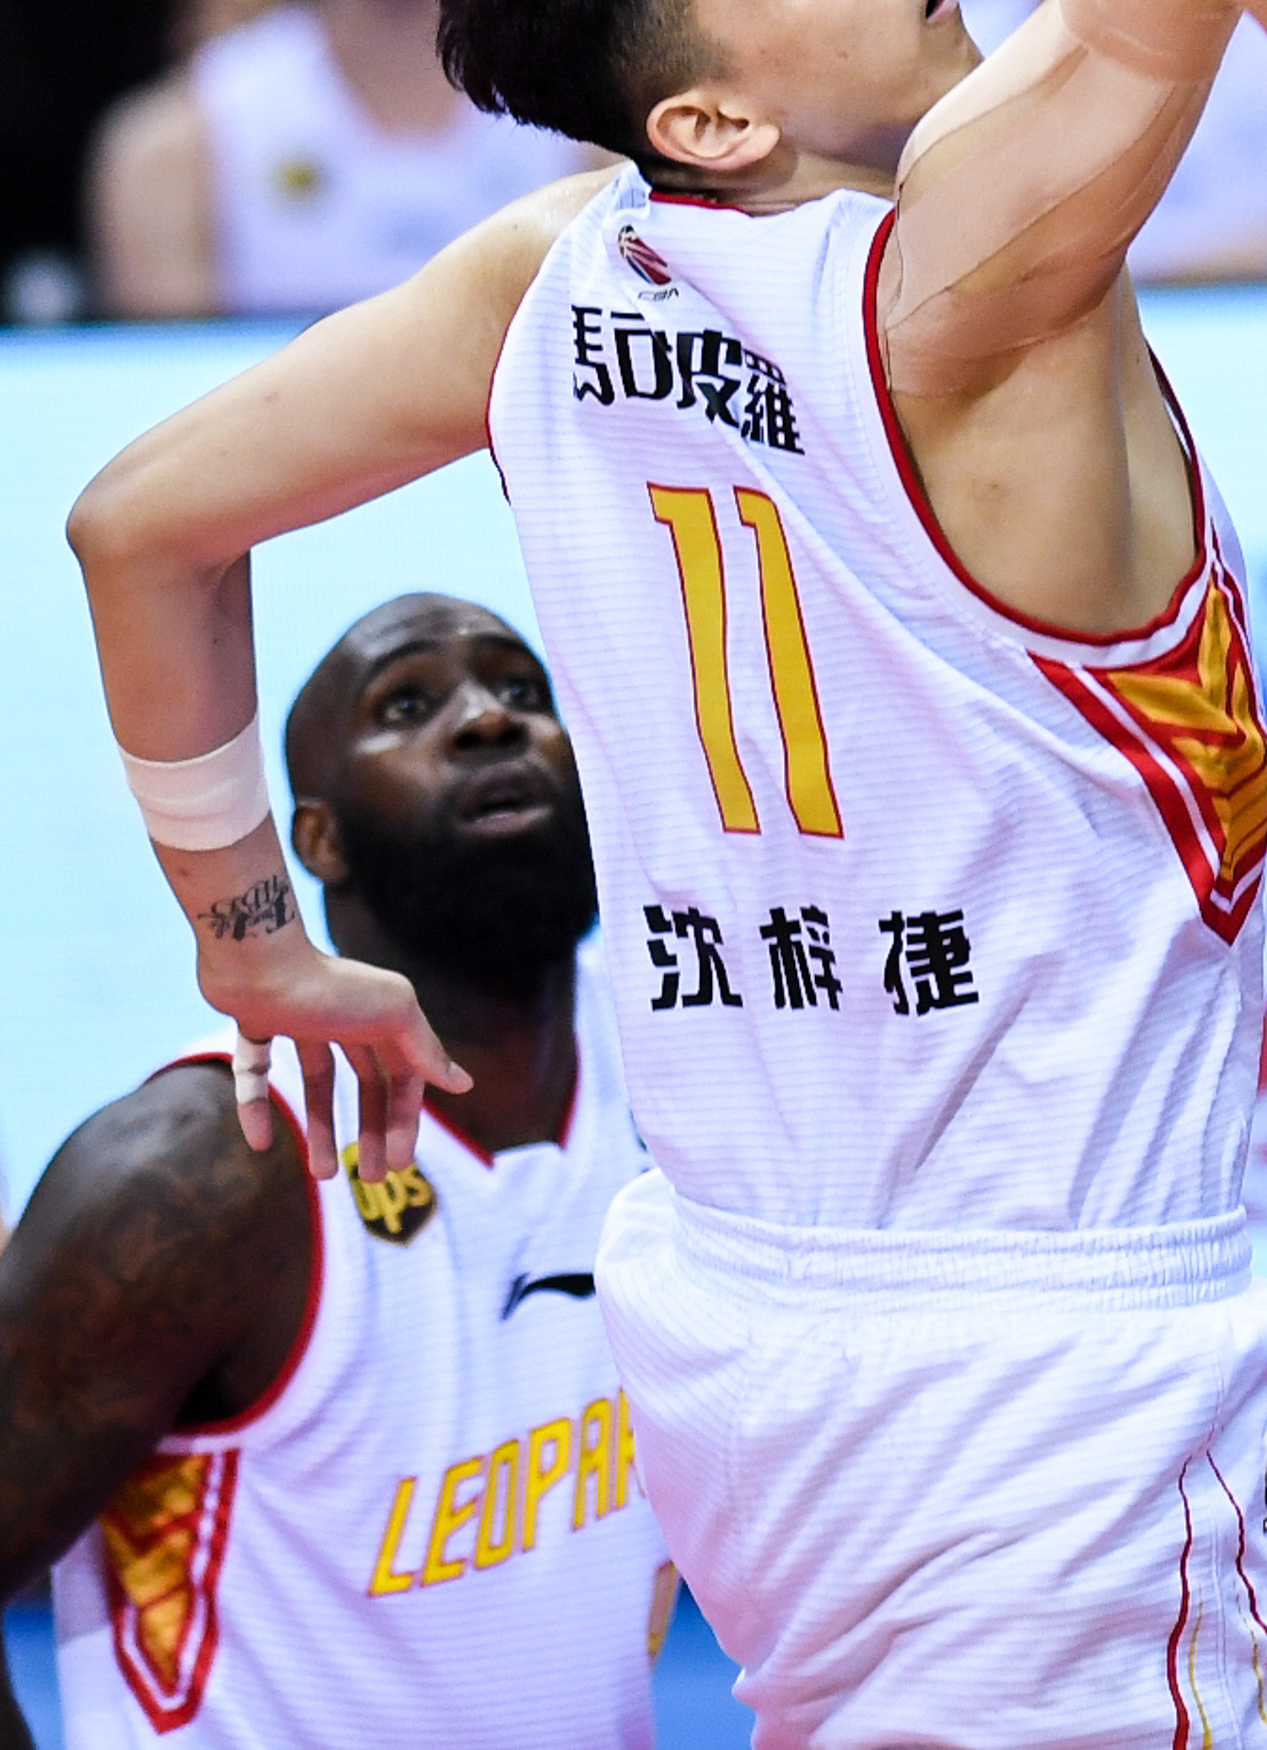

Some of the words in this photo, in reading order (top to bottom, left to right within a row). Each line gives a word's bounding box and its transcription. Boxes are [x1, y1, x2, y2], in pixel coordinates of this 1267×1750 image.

[646, 481, 844, 840] 11
[643, 904, 980, 1017] 沈梓捷
